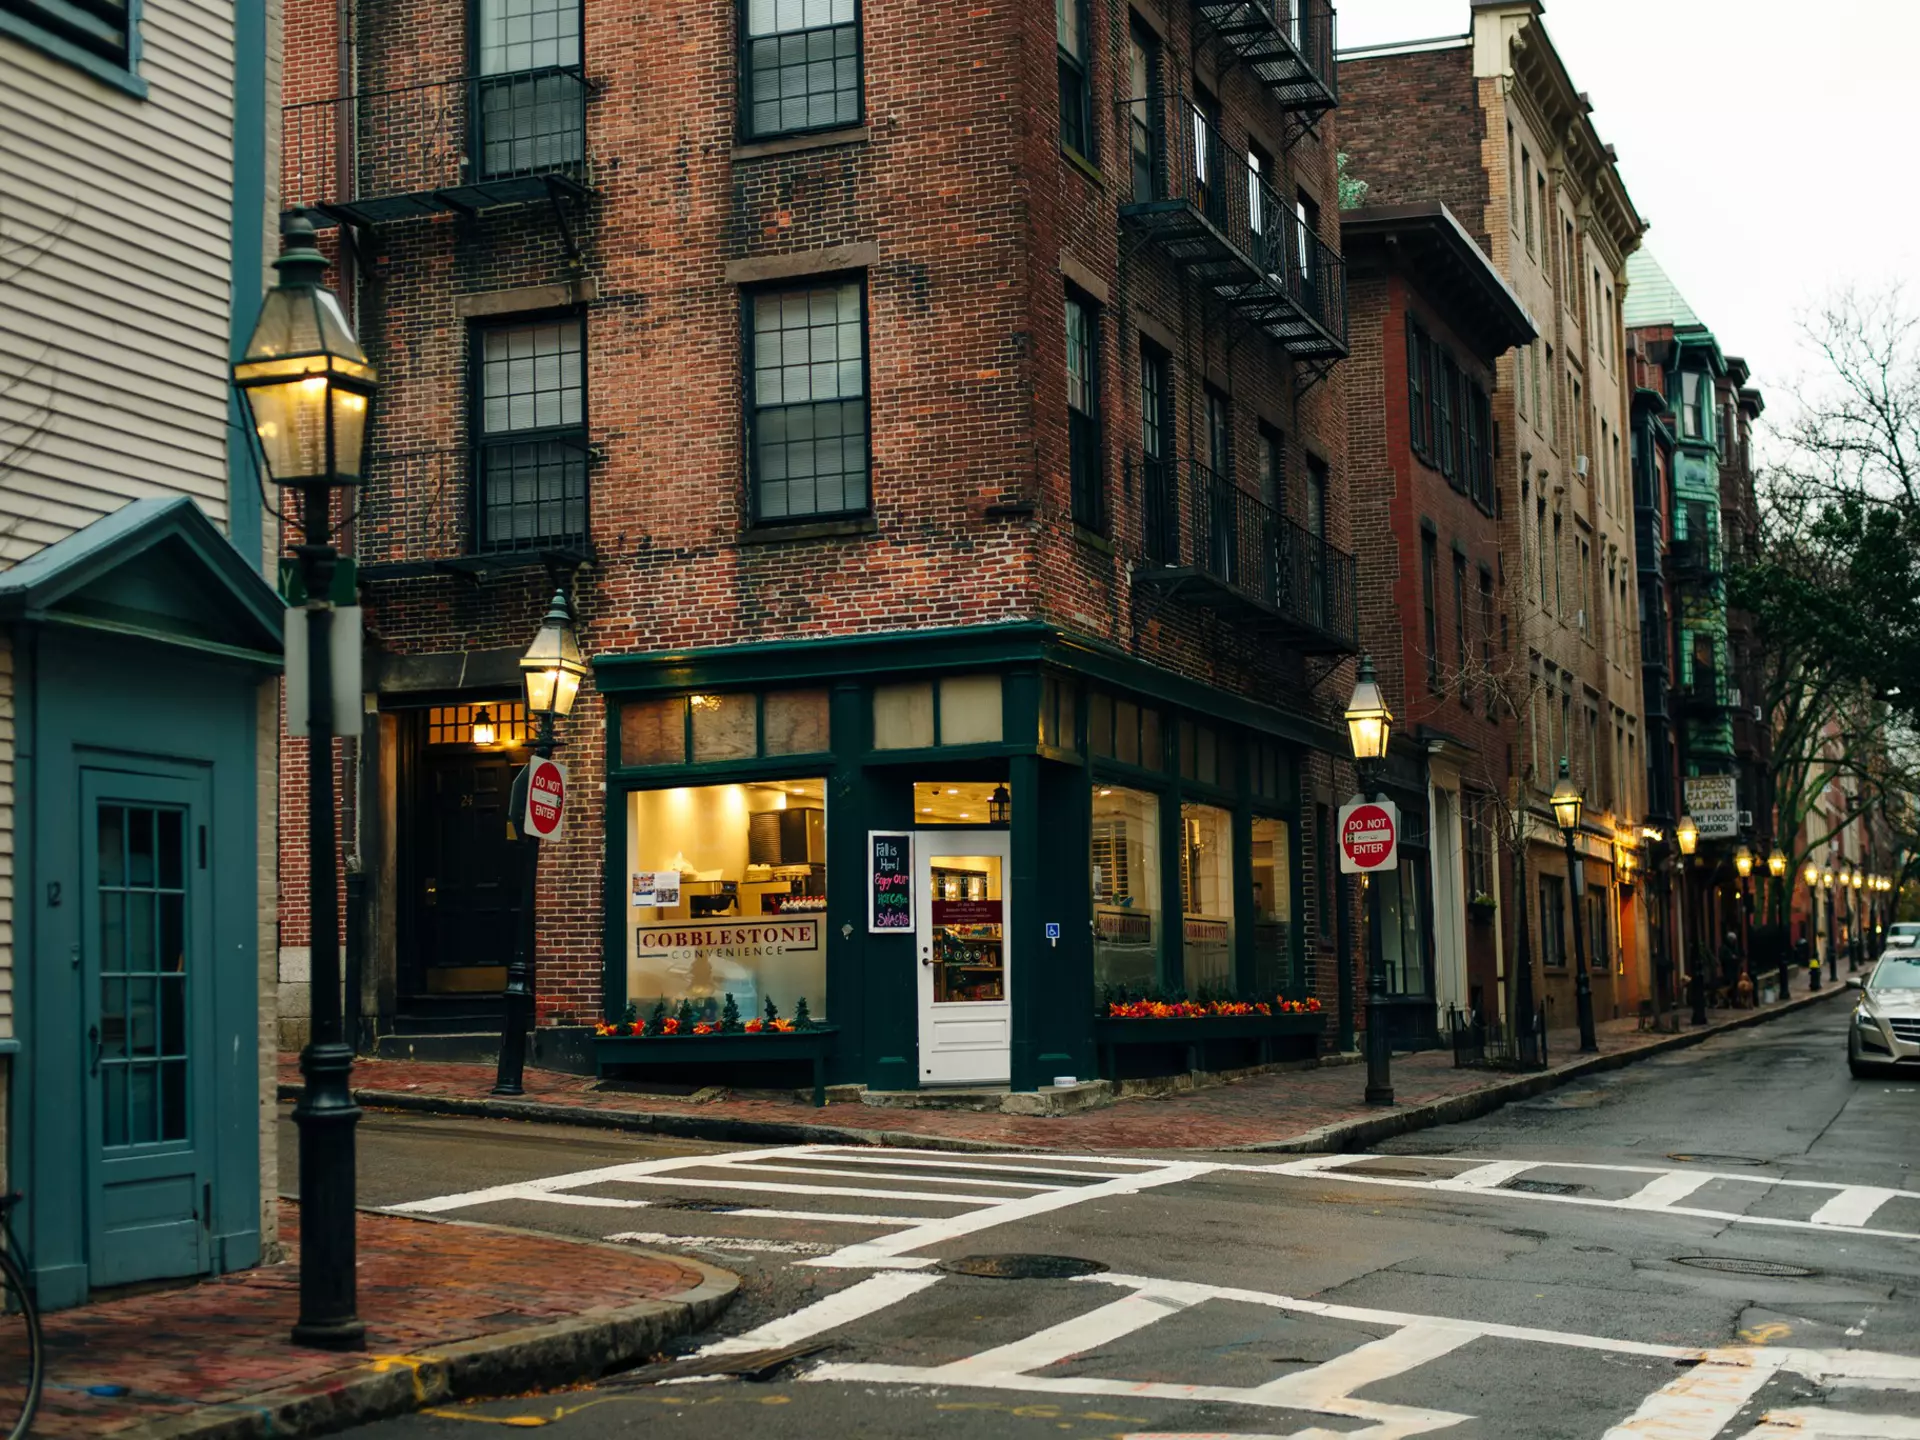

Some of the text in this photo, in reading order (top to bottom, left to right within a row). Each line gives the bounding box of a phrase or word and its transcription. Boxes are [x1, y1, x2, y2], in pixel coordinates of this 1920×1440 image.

[535, 776, 561, 792] DO NOT
[1687, 779, 1731, 790] BEACON
[1686, 790, 1733, 801] CAPITOL
[1687, 800, 1735, 811] MARKET
[535, 804, 556, 820] ENTER
[1708, 813, 1735, 823] FOODS
[1349, 818, 1386, 830] DO NOT
[1699, 823, 1729, 833] IQUORS
[876, 843, 897, 857] Fall is
[1353, 843, 1383, 855] ENTER
[47, 881, 61, 908] 12
[642, 926, 811, 948] COBBLESTONE
[671, 945, 783, 960] CONVENIENCE
